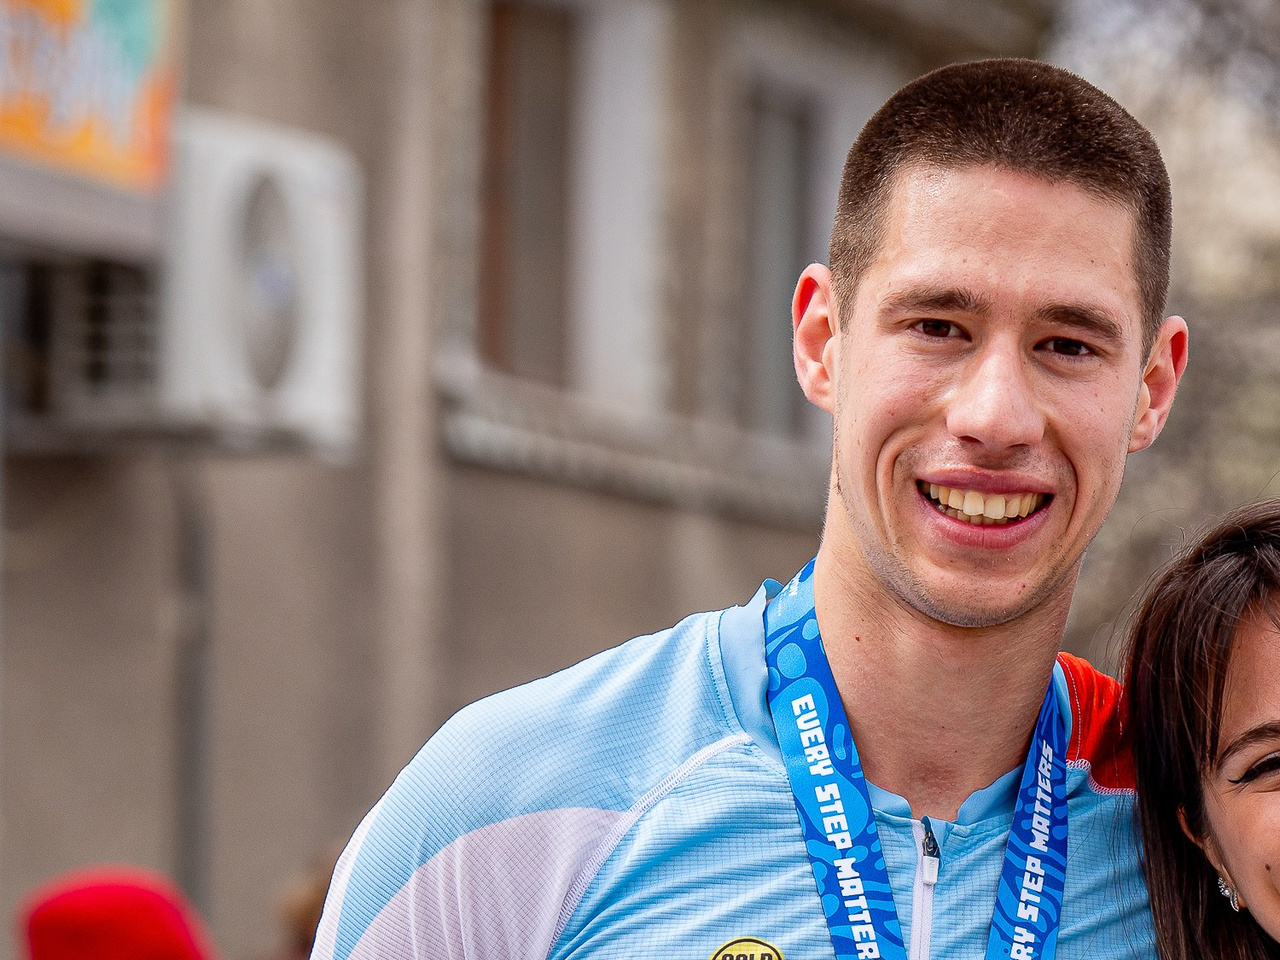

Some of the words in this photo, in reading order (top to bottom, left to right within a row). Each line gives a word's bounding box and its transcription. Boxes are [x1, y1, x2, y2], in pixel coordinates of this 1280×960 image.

[815, 782, 852, 850] STEP
[1030, 739, 1053, 852] MATTERS
[1017, 855, 1046, 923] STEP
